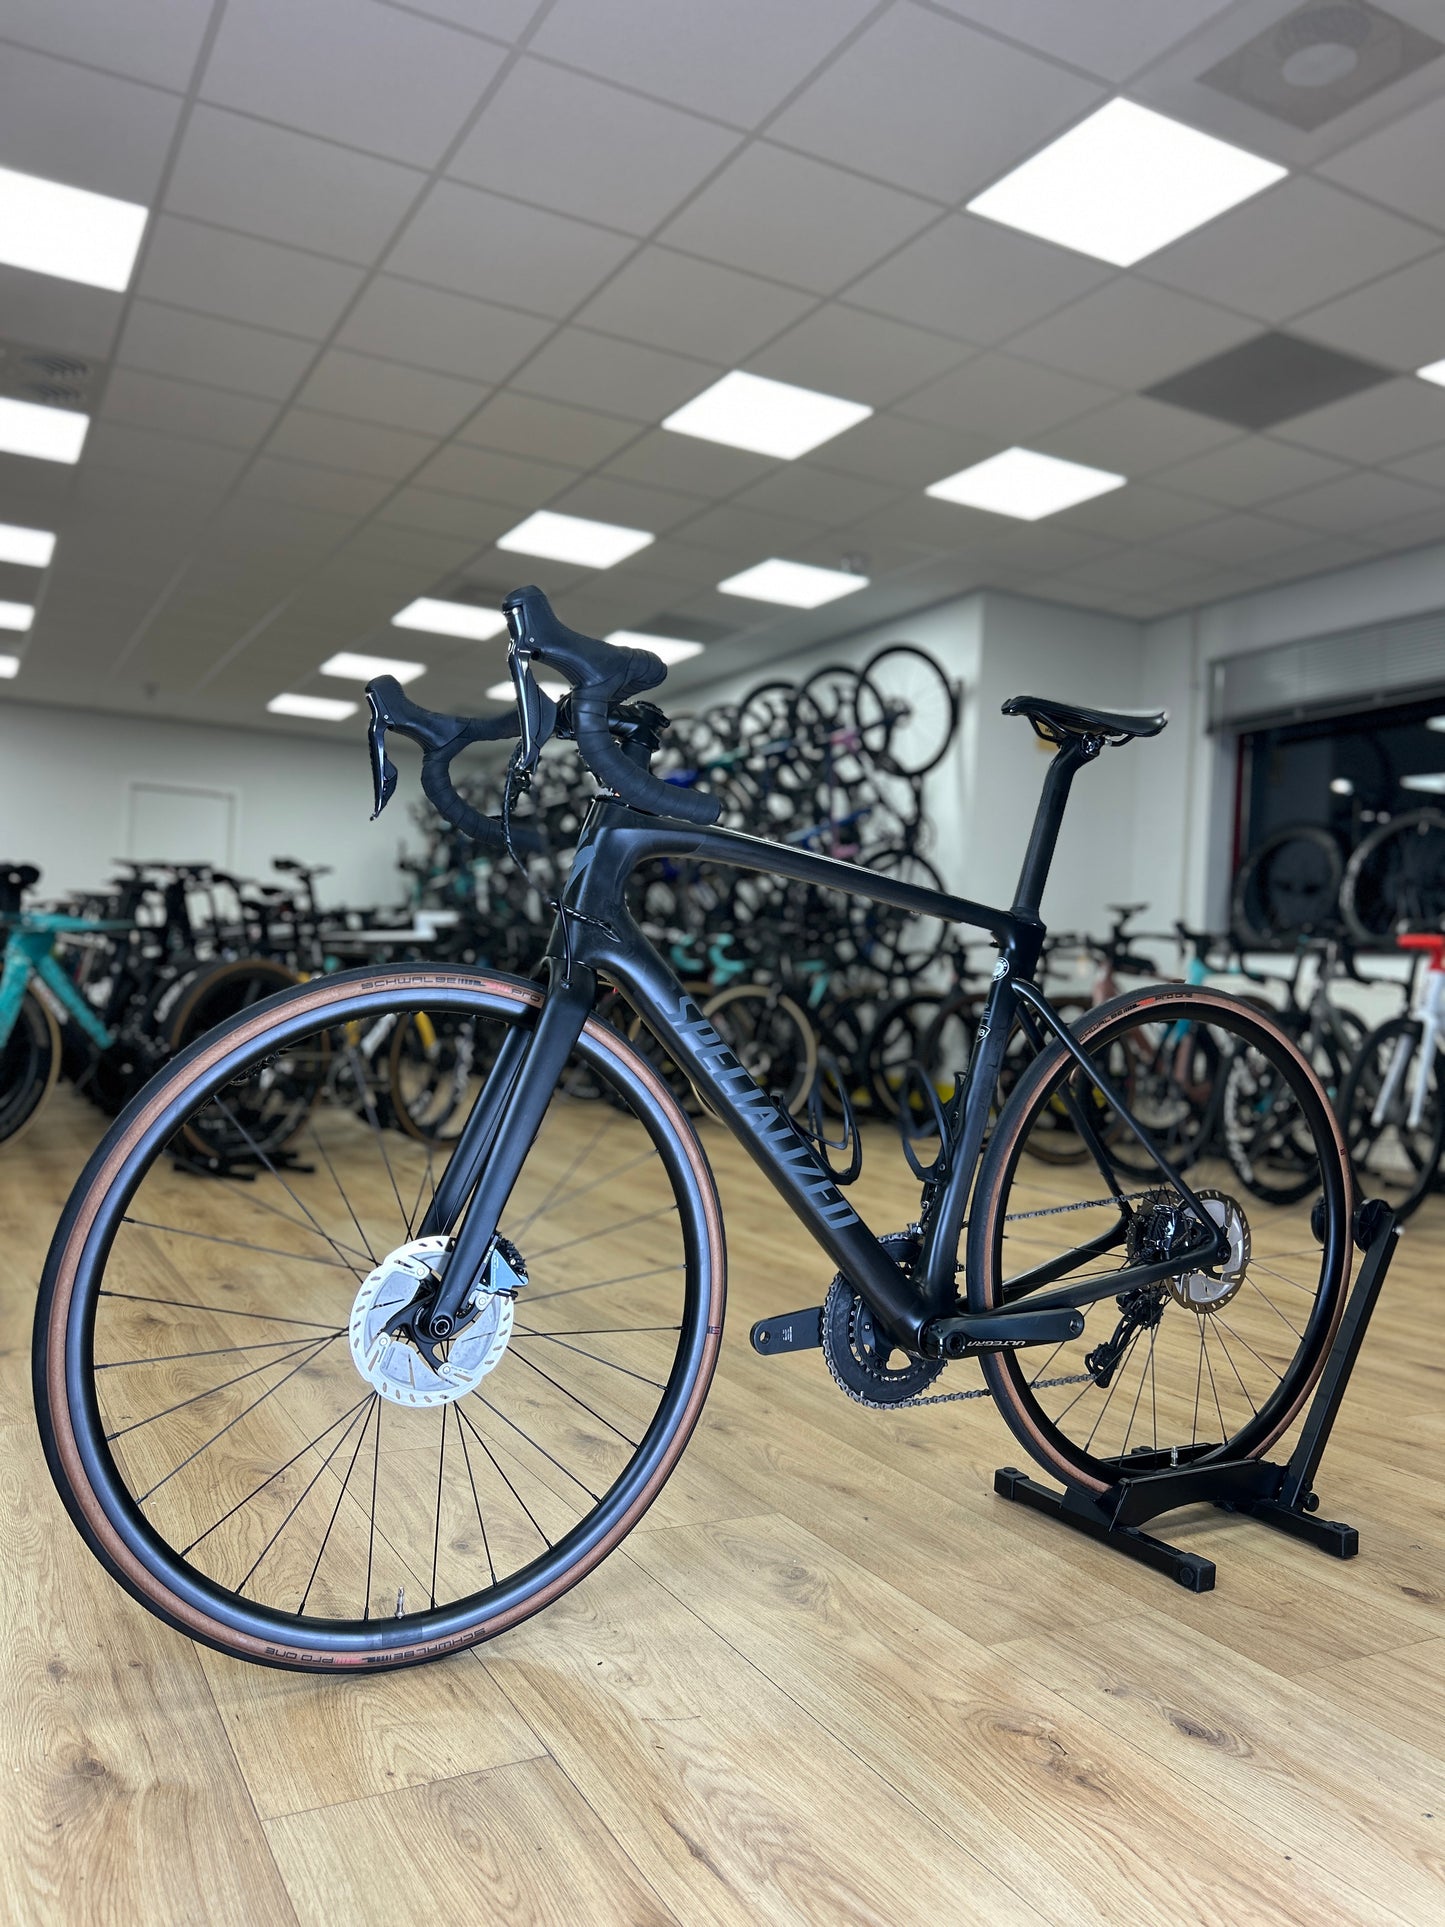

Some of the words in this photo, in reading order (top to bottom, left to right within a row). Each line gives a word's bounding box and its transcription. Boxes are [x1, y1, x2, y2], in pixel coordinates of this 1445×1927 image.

[361, 976, 456, 990] SCHWALBE
[657, 995, 859, 1230] SPECIALIZED
[393, 1627, 486, 1660] SCHWALBE
